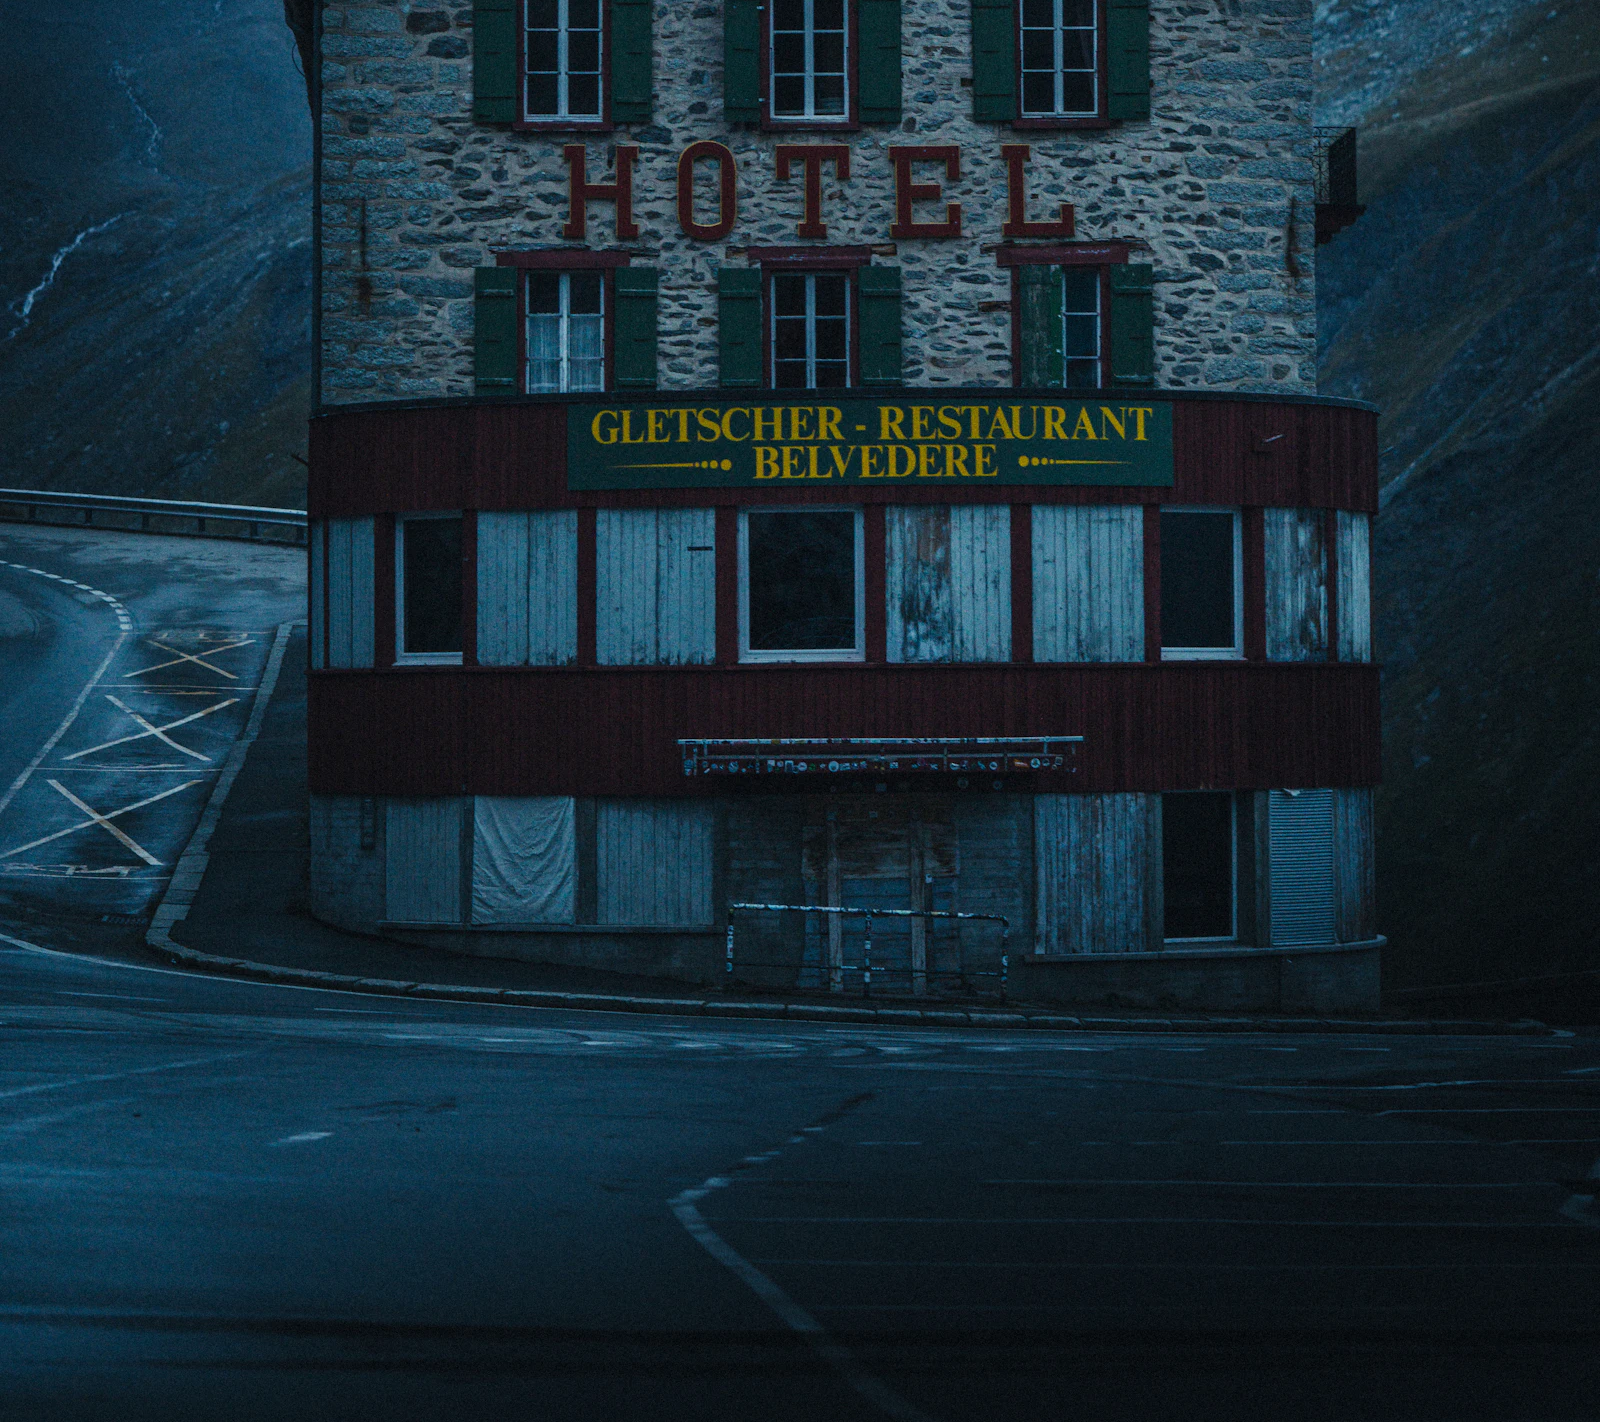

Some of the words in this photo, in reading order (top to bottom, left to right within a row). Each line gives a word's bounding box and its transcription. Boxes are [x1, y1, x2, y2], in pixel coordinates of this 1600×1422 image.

[563, 140, 1075, 240] HOTEL
[591, 406, 845, 445] GLETSCHER
[878, 405, 1153, 441] RESTAURANT
[753, 444, 999, 479] BELVEDERE
